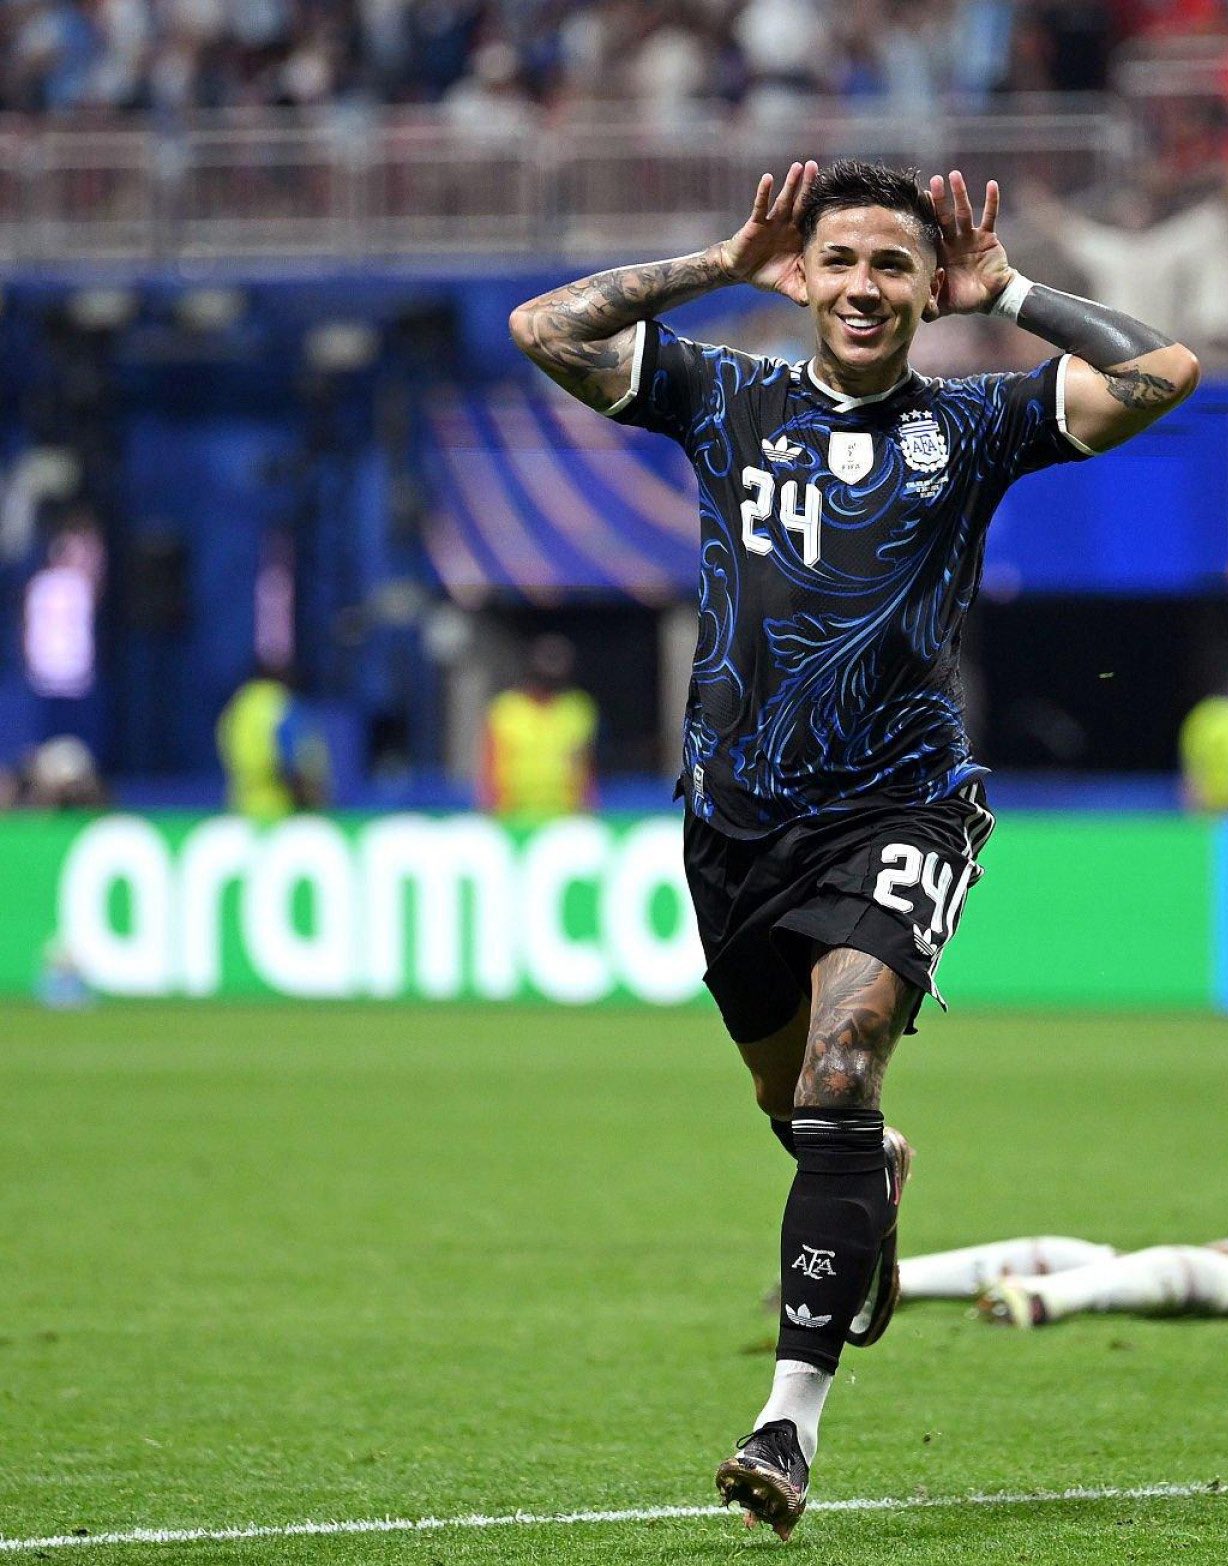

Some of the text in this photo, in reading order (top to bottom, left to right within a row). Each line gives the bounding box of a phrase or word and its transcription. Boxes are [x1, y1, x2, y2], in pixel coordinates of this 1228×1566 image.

[739, 465, 822, 568] 24
[60, 814, 708, 1006] aramco
[873, 843, 953, 933] 24
[791, 1243, 837, 1280] AFA
